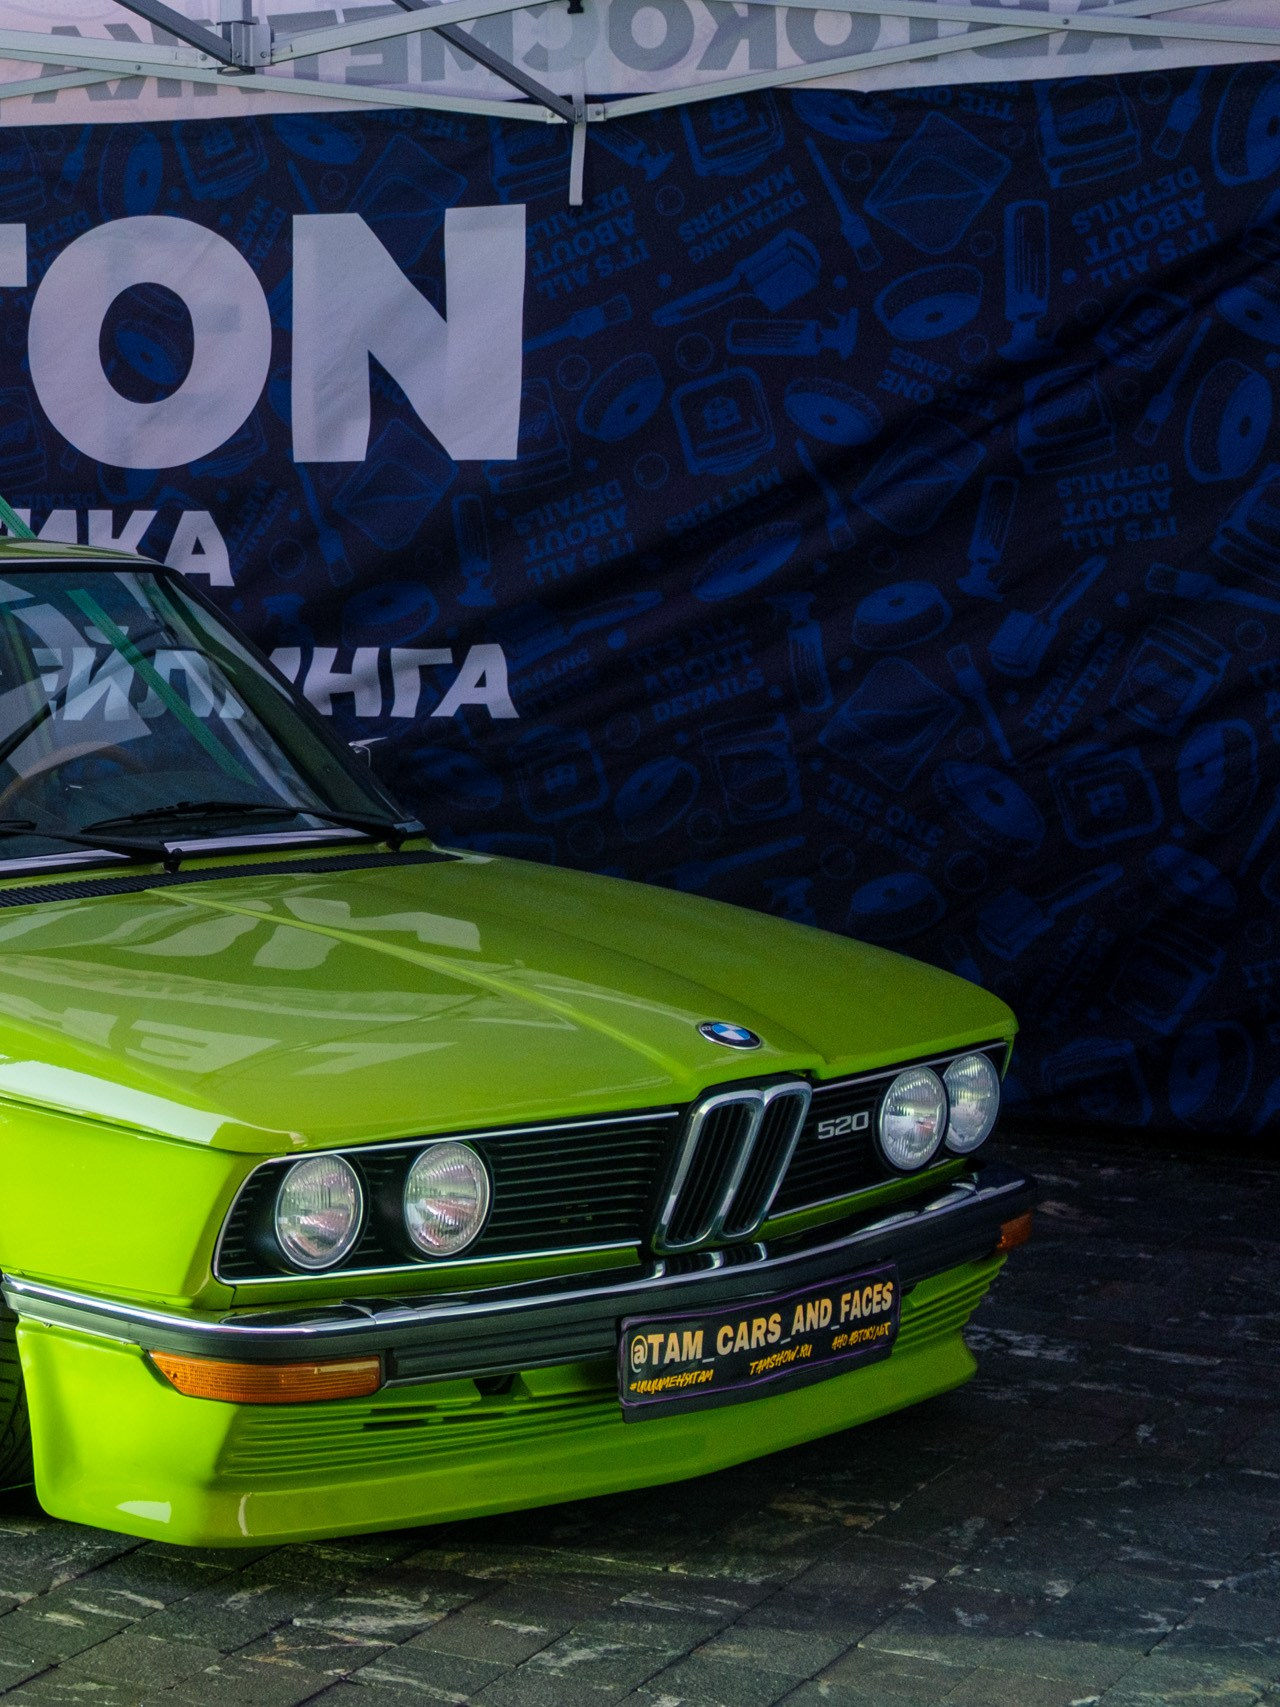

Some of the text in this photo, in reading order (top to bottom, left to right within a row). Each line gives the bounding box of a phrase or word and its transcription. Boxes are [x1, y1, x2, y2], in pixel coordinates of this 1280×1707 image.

[678, 164, 797, 243] MATTERS
[689, 188, 808, 264] DETAILING
[1070, 164, 1202, 235] DETAILS
[1083, 189, 1208, 265] ABOUT
[531, 210, 637, 278] ABOUT
[1089, 252, 1152, 289] ALL
[878, 366, 936, 405] ONE
[511, 477, 626, 537] DETAILS
[1055, 461, 1173, 500] DETAILS
[1058, 486, 1174, 527] ABOUT
[522, 502, 629, 564] ABOUT
[1062, 525, 1116, 552] ALL
[643, 638, 755, 698] ABOUT
[651, 667, 766, 726] DETAILS
[1021, 614, 1103, 733] DETAILING
[1040, 628, 1126, 744] MATTERS
[817, 1110, 869, 1140] 520
[631, 1281, 894, 1373] @TAM_CARS_AND_FACES
